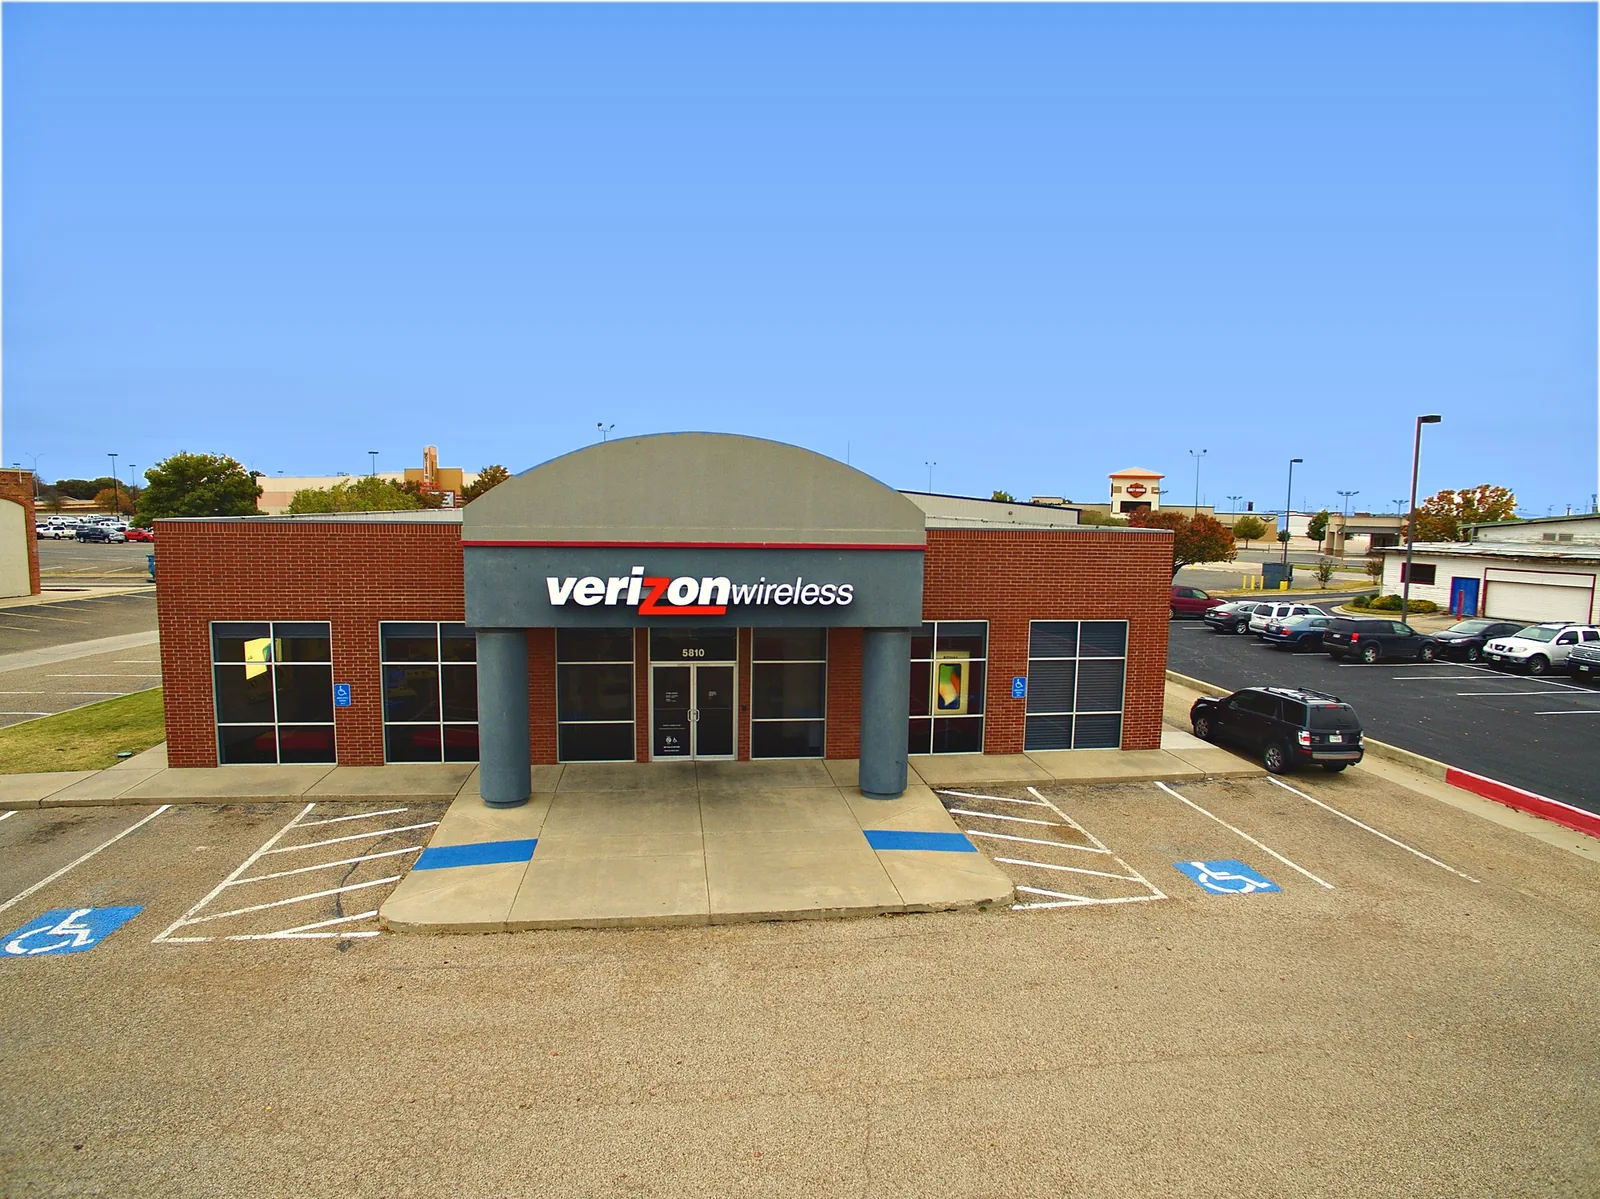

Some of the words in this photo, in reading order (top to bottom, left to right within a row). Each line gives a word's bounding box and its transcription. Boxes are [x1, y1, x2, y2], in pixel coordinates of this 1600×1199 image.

[546, 566, 731, 615] verizon
[732, 577, 854, 605] wireless
[682, 649, 705, 657] 5810
